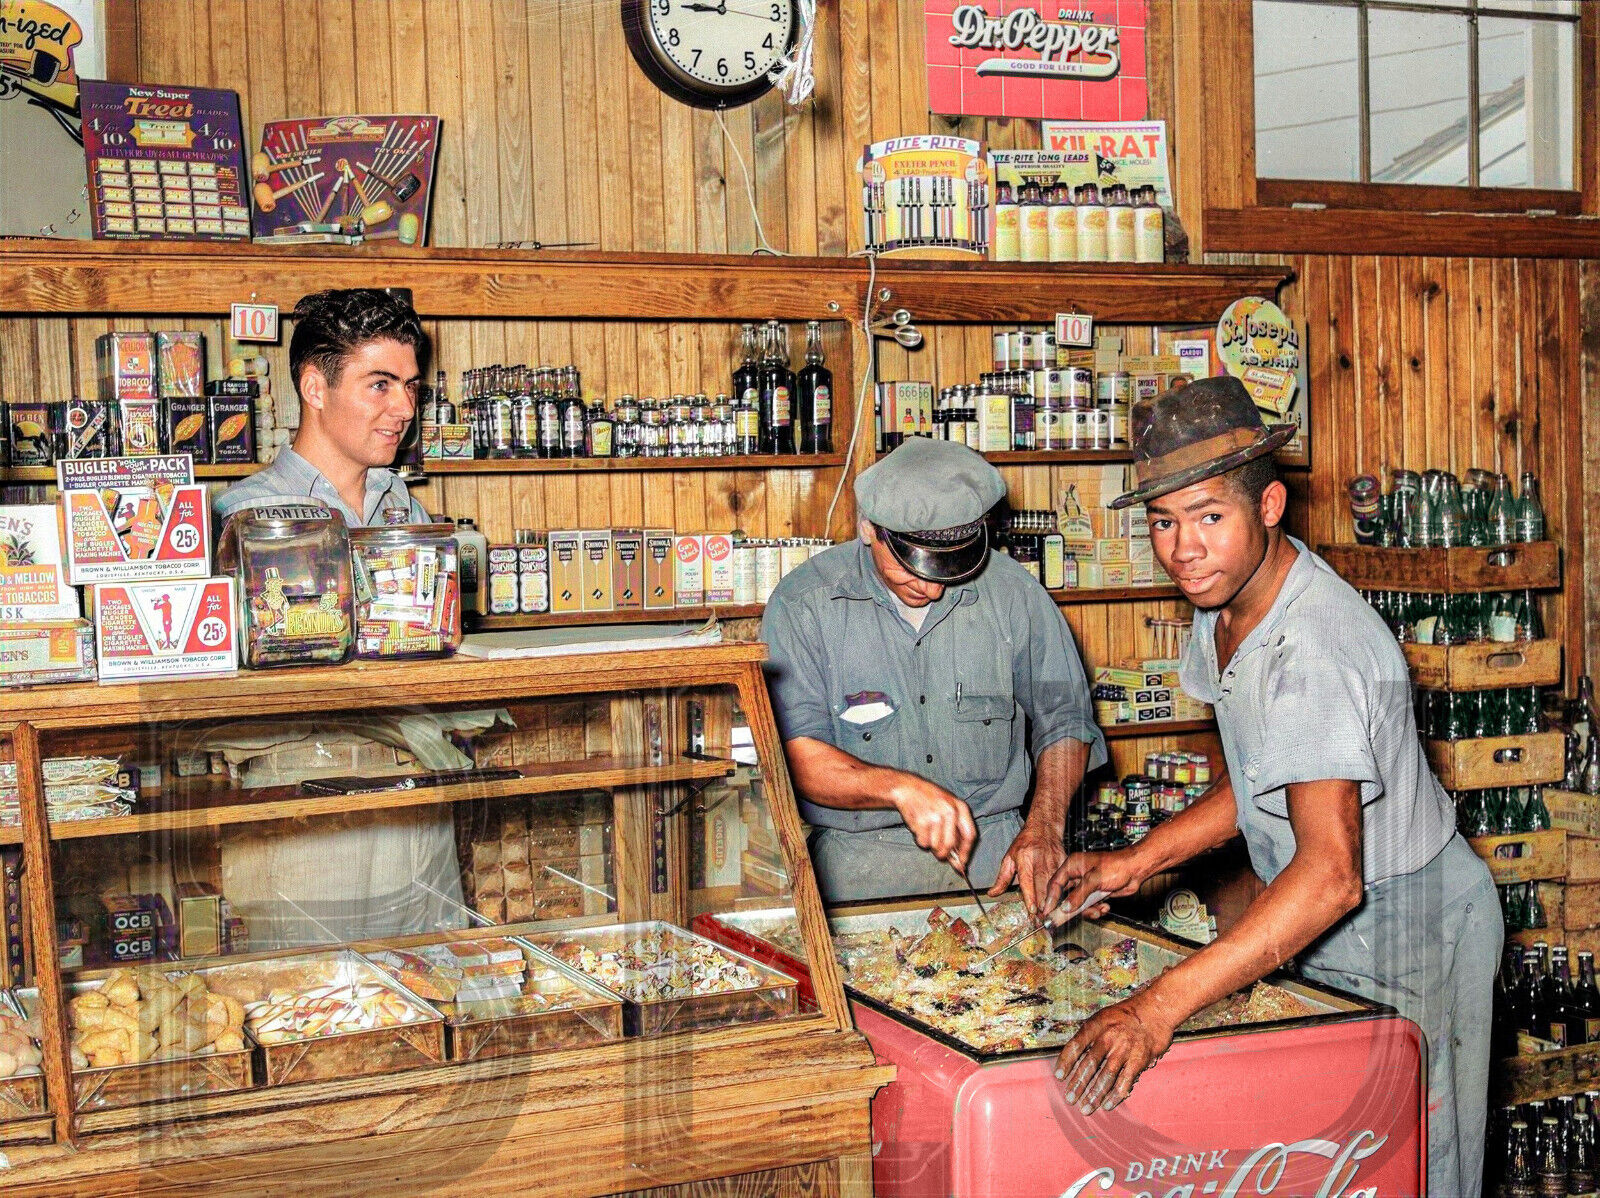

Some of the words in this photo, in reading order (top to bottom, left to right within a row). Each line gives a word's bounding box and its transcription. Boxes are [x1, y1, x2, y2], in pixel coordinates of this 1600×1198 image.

[770, 4, 781, 22] 3
[1058, 8, 1094, 21] DRINK
[669, 28, 680, 46] 8
[762, 33, 773, 49] 4
[692, 50, 702, 68] 7
[744, 51, 755, 70] 5
[717, 58, 728, 76] 6
[1011, 62, 1035, 70] GOOD
[1039, 63, 1055, 71] FOR
[1057, 64, 1077, 72] LIFE
[129, 88, 154, 98] New
[157, 90, 189, 100] Super
[124, 98, 194, 117] Treet
[88, 118, 100, 131] 4
[198, 122, 211, 136] 4
[884, 136, 967, 153] RITE-RITE
[1038, 153, 1060, 163] LONG
[1064, 154, 1089, 163] LEADS
[239, 309, 273, 336] 10¢
[1060, 318, 1088, 341] 10¢
[1240, 356, 1299, 368] ASPIRIN
[899, 386, 918, 398] 666
[171, 403, 206, 411] GRANGER
[214, 403, 249, 411] GRANGER
[65, 461, 117, 475] BUGLER
[150, 459, 187, 471] PACK
[162, 471, 188, 479] TOBACCO
[179, 502, 194, 510] ALL
[179, 511, 195, 523] for
[176, 529, 198, 548] 25¢
[585, 540, 608, 549] SHINOLA
[649, 539, 672, 548] SHINOLA
[554, 542, 577, 550] SHINOLA
[616, 542, 640, 550] SHINOLA
[113, 564, 152, 572] WILLIAMSON
[15, 572, 54, 584] MELLOW
[6, 590, 55, 604] TOBACCOS
[206, 603, 222, 615] for
[203, 623, 224, 641] 25¢
[119, 772, 130, 788] B
[115, 915, 151, 929] OCB
[115, 940, 152, 955] OCB
[1125, 1149, 1229, 1184] DRINK
